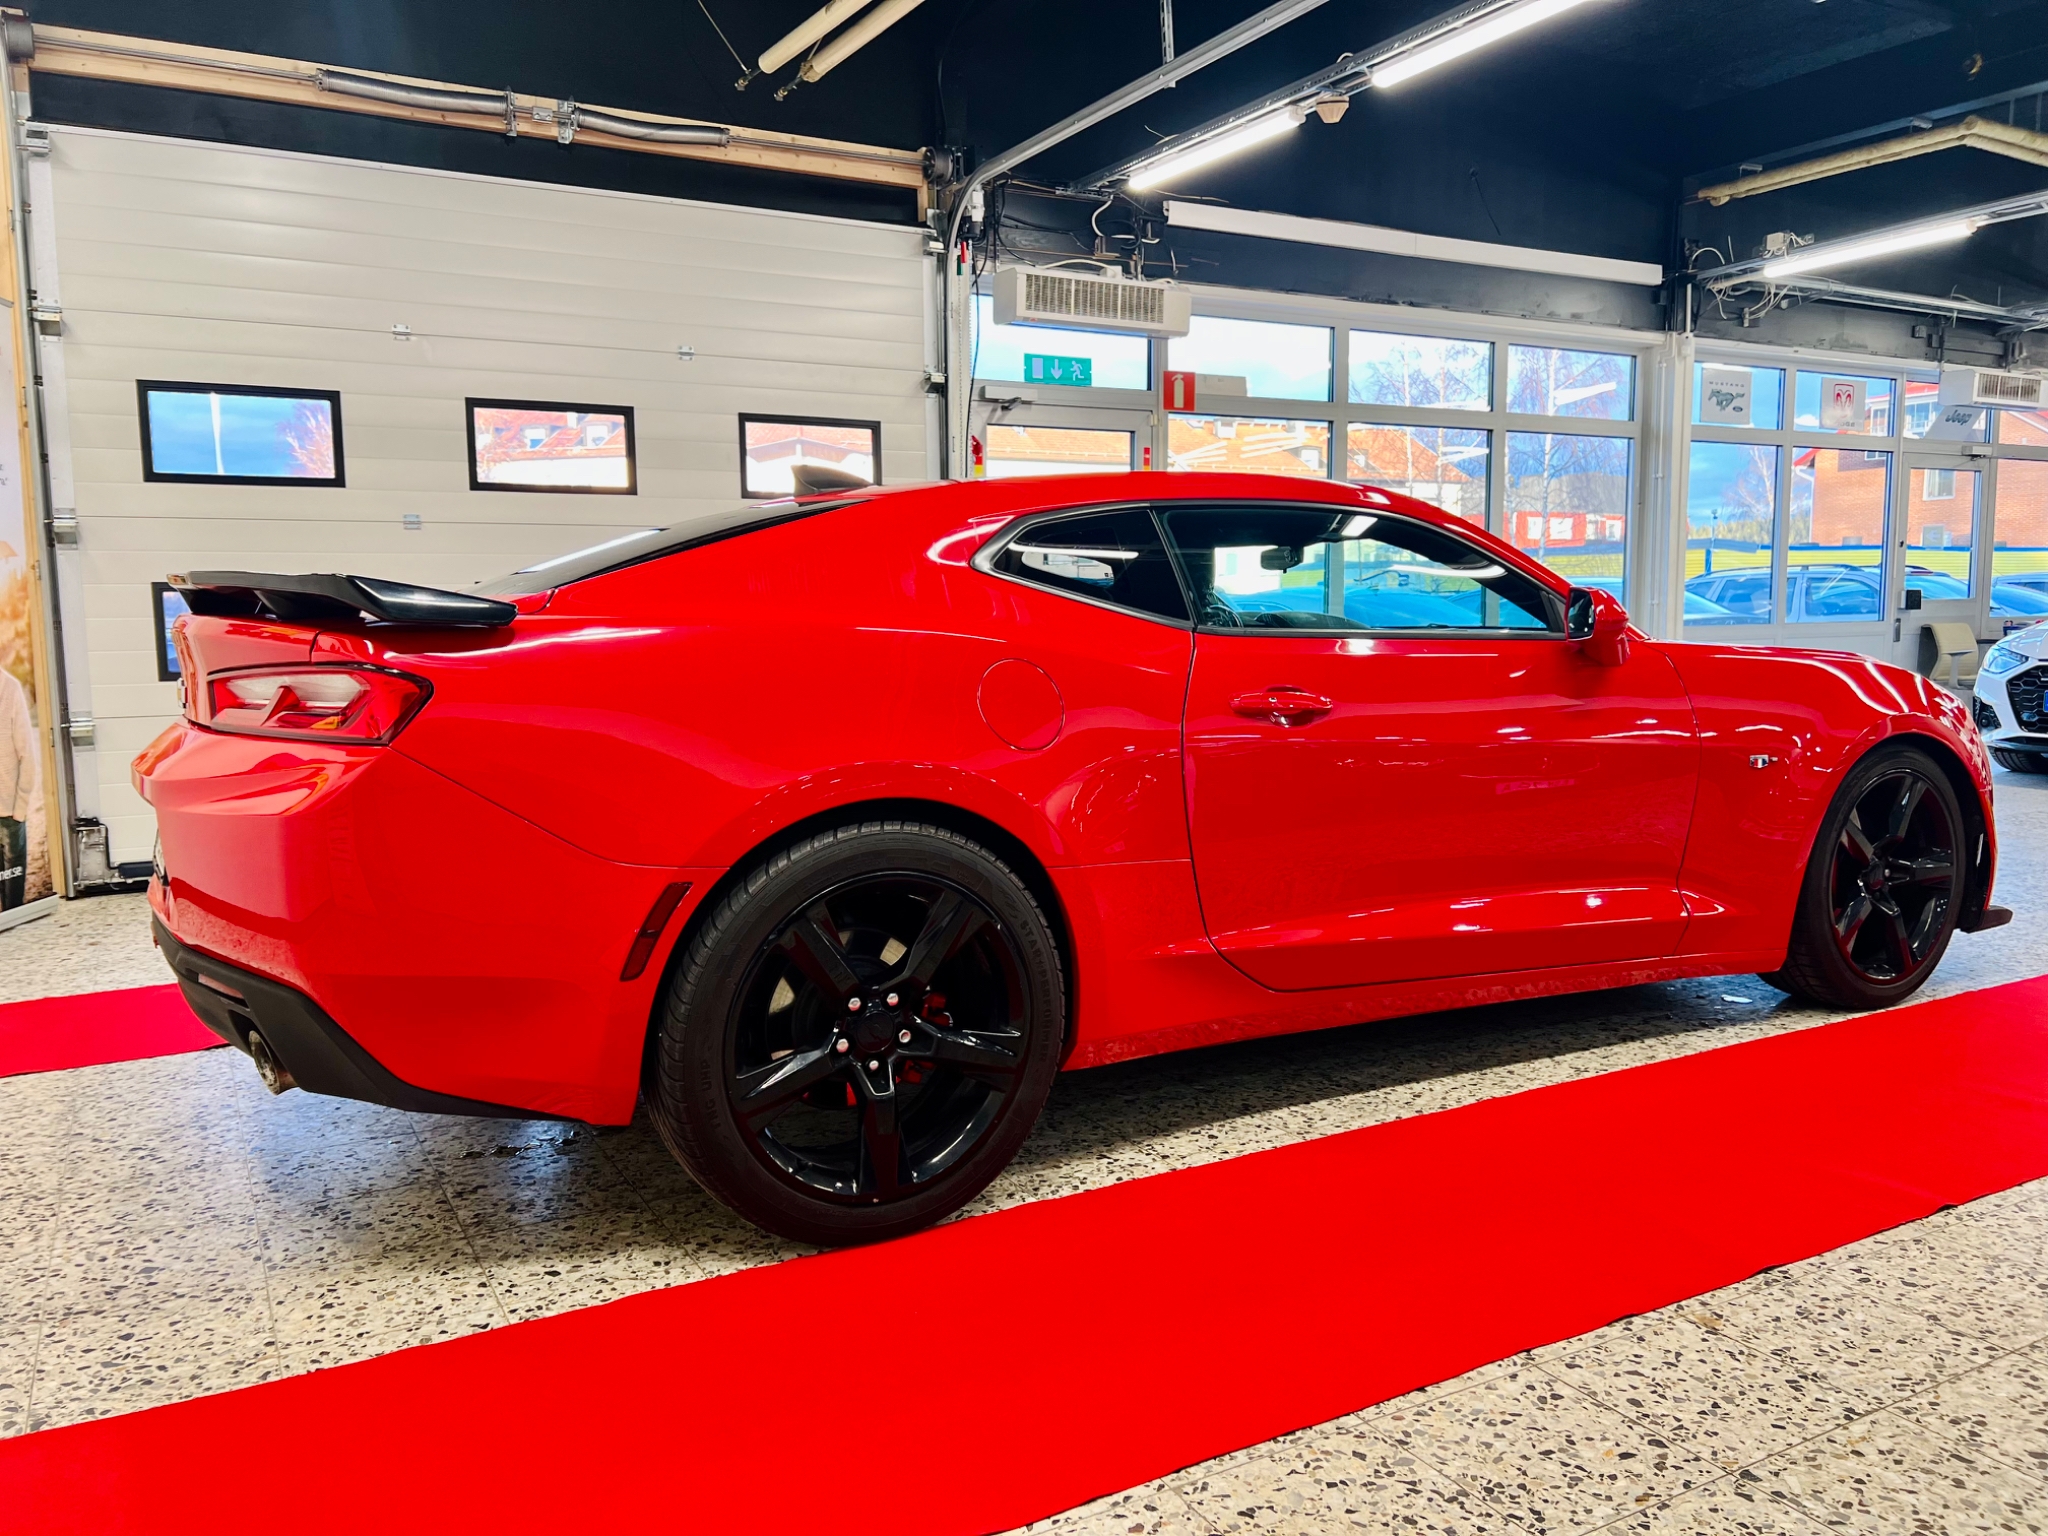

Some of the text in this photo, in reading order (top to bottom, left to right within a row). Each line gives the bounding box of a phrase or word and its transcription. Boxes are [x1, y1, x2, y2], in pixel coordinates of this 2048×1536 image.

[1708, 380, 1745, 388] MUSTANG
[1945, 409, 1973, 426] Jeep
[1020, 920, 1053, 1063] STAR PERFORMER
